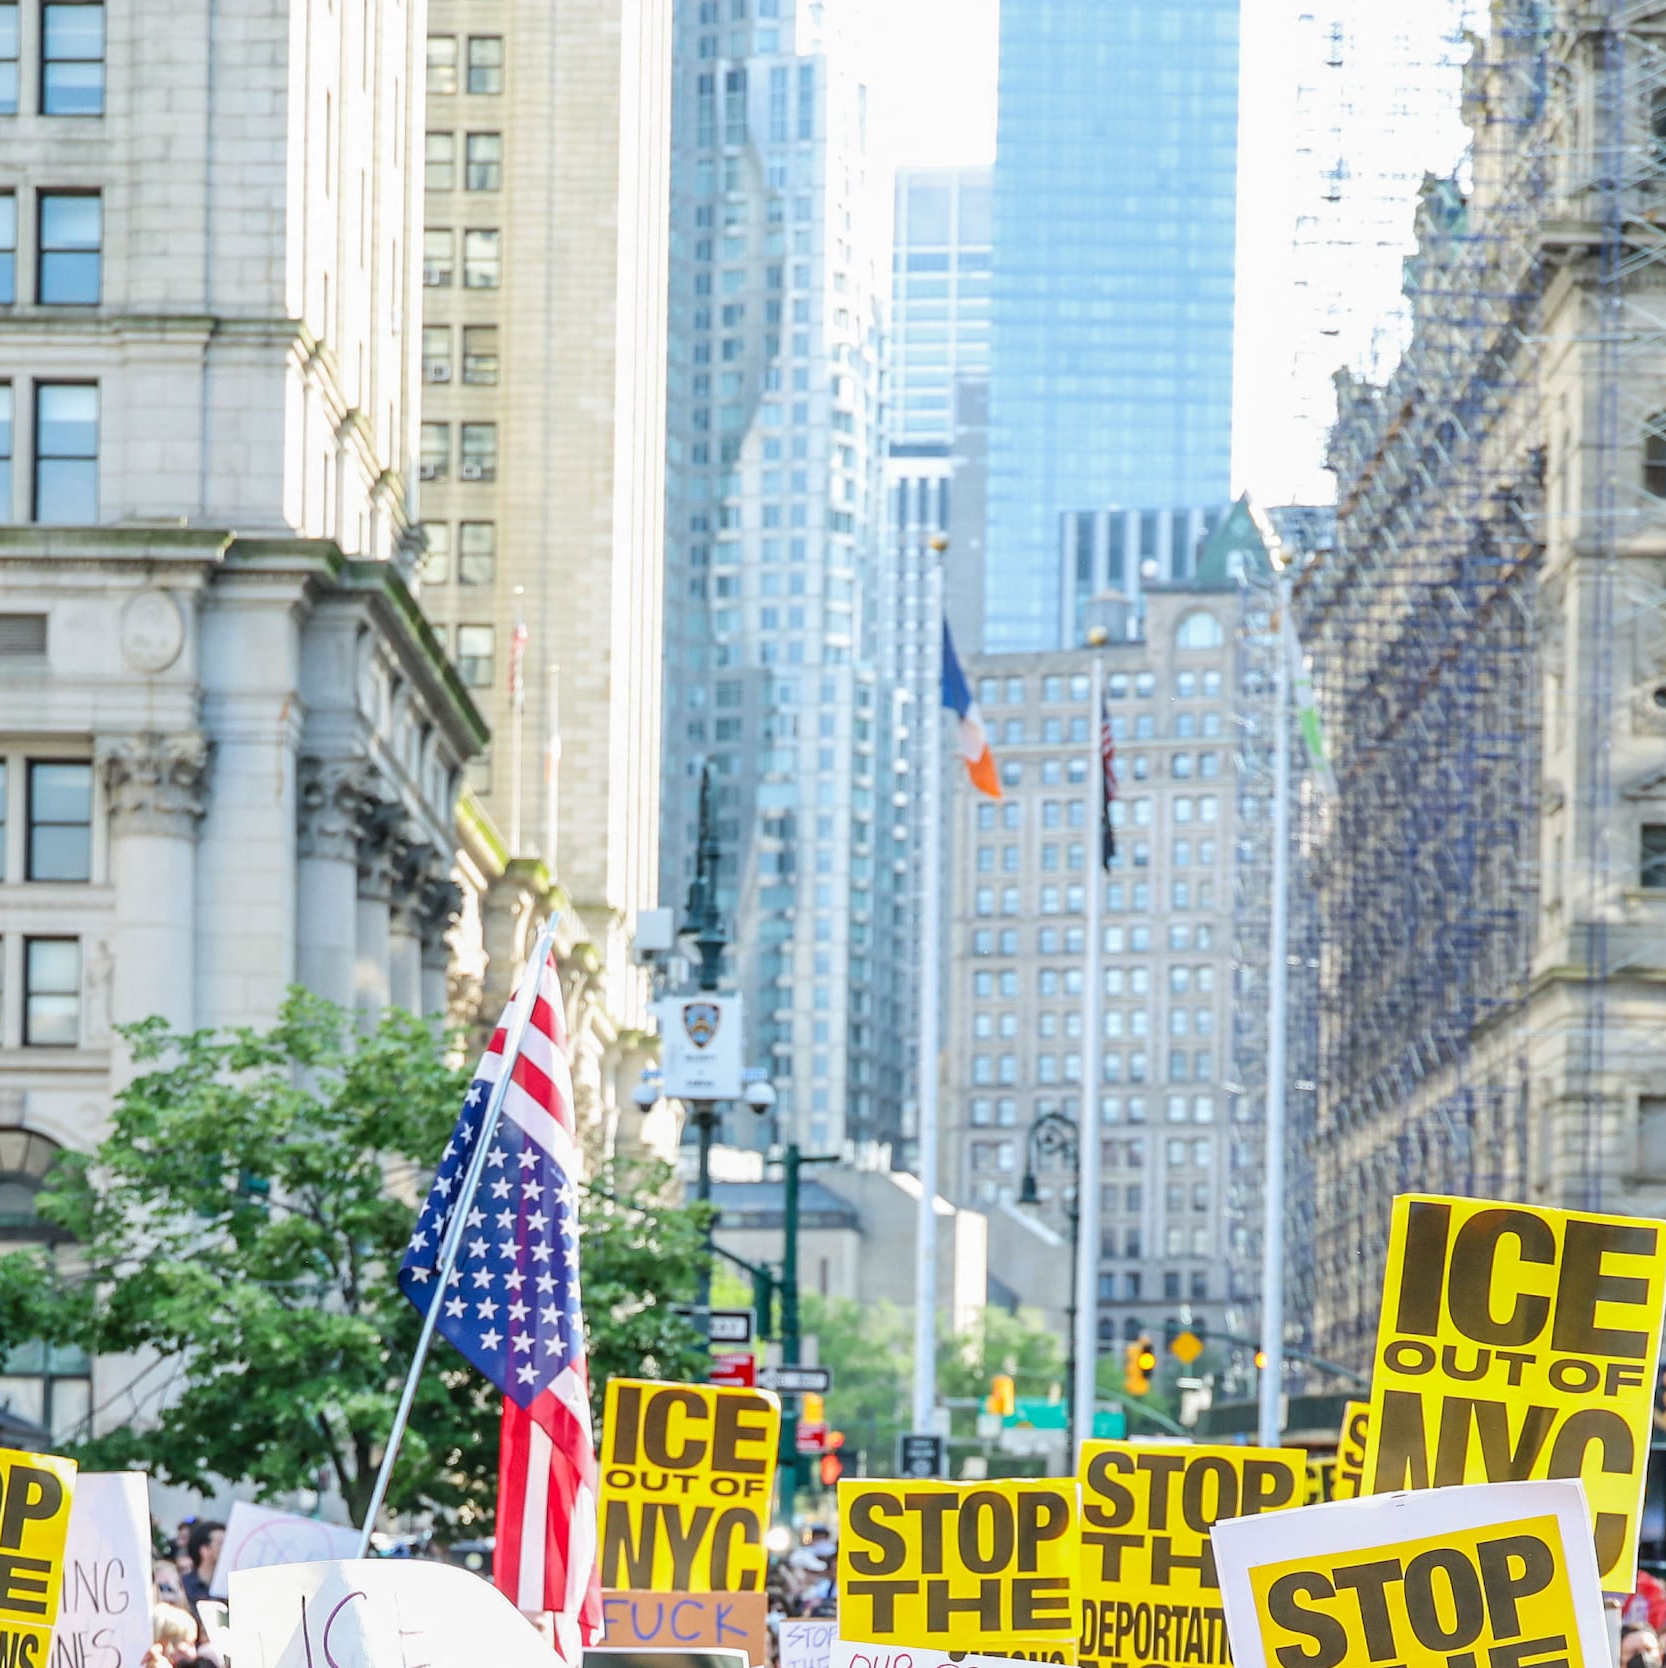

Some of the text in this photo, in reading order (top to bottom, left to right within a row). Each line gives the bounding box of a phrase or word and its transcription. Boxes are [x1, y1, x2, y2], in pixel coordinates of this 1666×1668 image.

[1395, 1201, 1658, 1359] ICE
[1383, 1340, 1645, 1396] OUT OF
[612, 1388, 767, 1475] ICE
[606, 1470, 765, 1498] OUT OF
[1082, 1451, 1295, 1533] STOP
[603, 1501, 760, 1592] NYC
[847, 1490, 1071, 1576] STOP
[602, 1599, 748, 1643] FUCK
[786, 1625, 838, 1648] STOP
[846, 1577, 1073, 1634] THE
